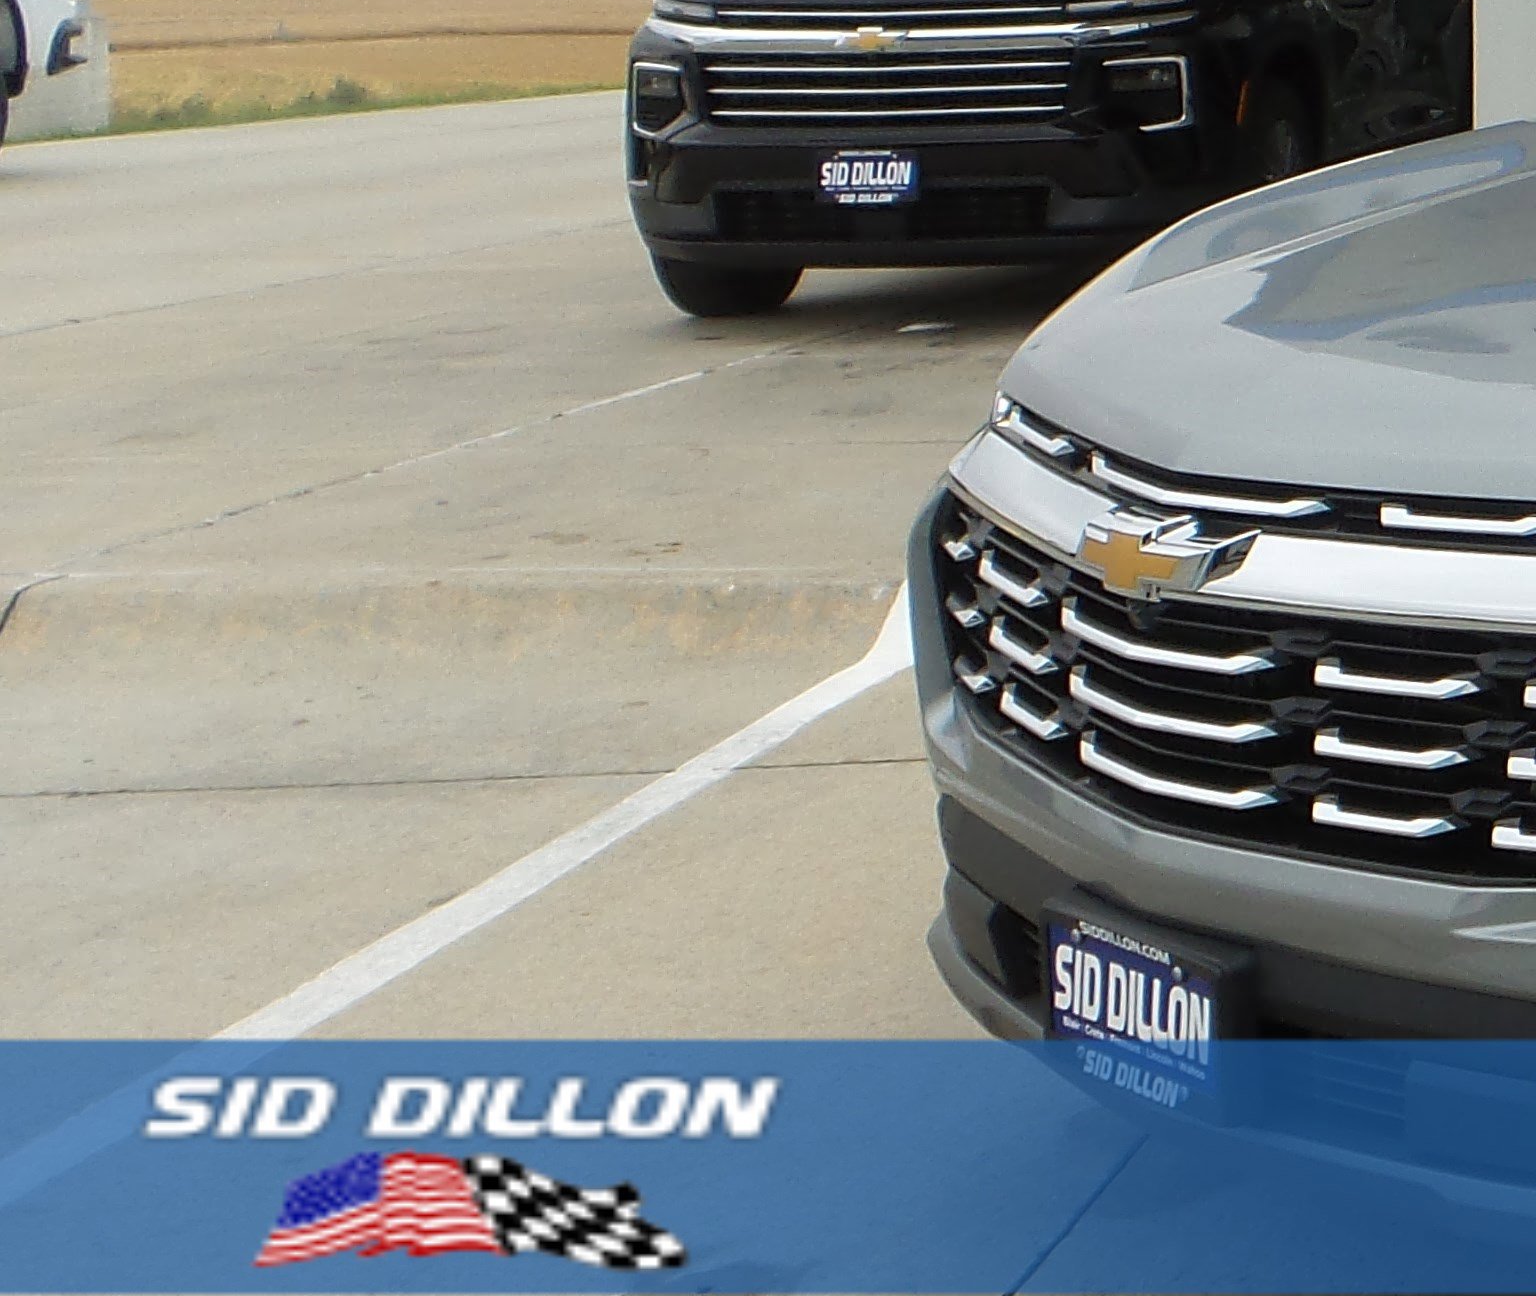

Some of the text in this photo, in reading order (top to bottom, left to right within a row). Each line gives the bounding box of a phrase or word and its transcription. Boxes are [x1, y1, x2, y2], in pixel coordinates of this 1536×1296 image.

[821, 161, 911, 185] SID DILLON
[1079, 920, 1171, 965] SIDDILLON.COM
[1054, 944, 1210, 1066] SID DILLON
[1082, 1050, 1179, 1108] SID DILLON
